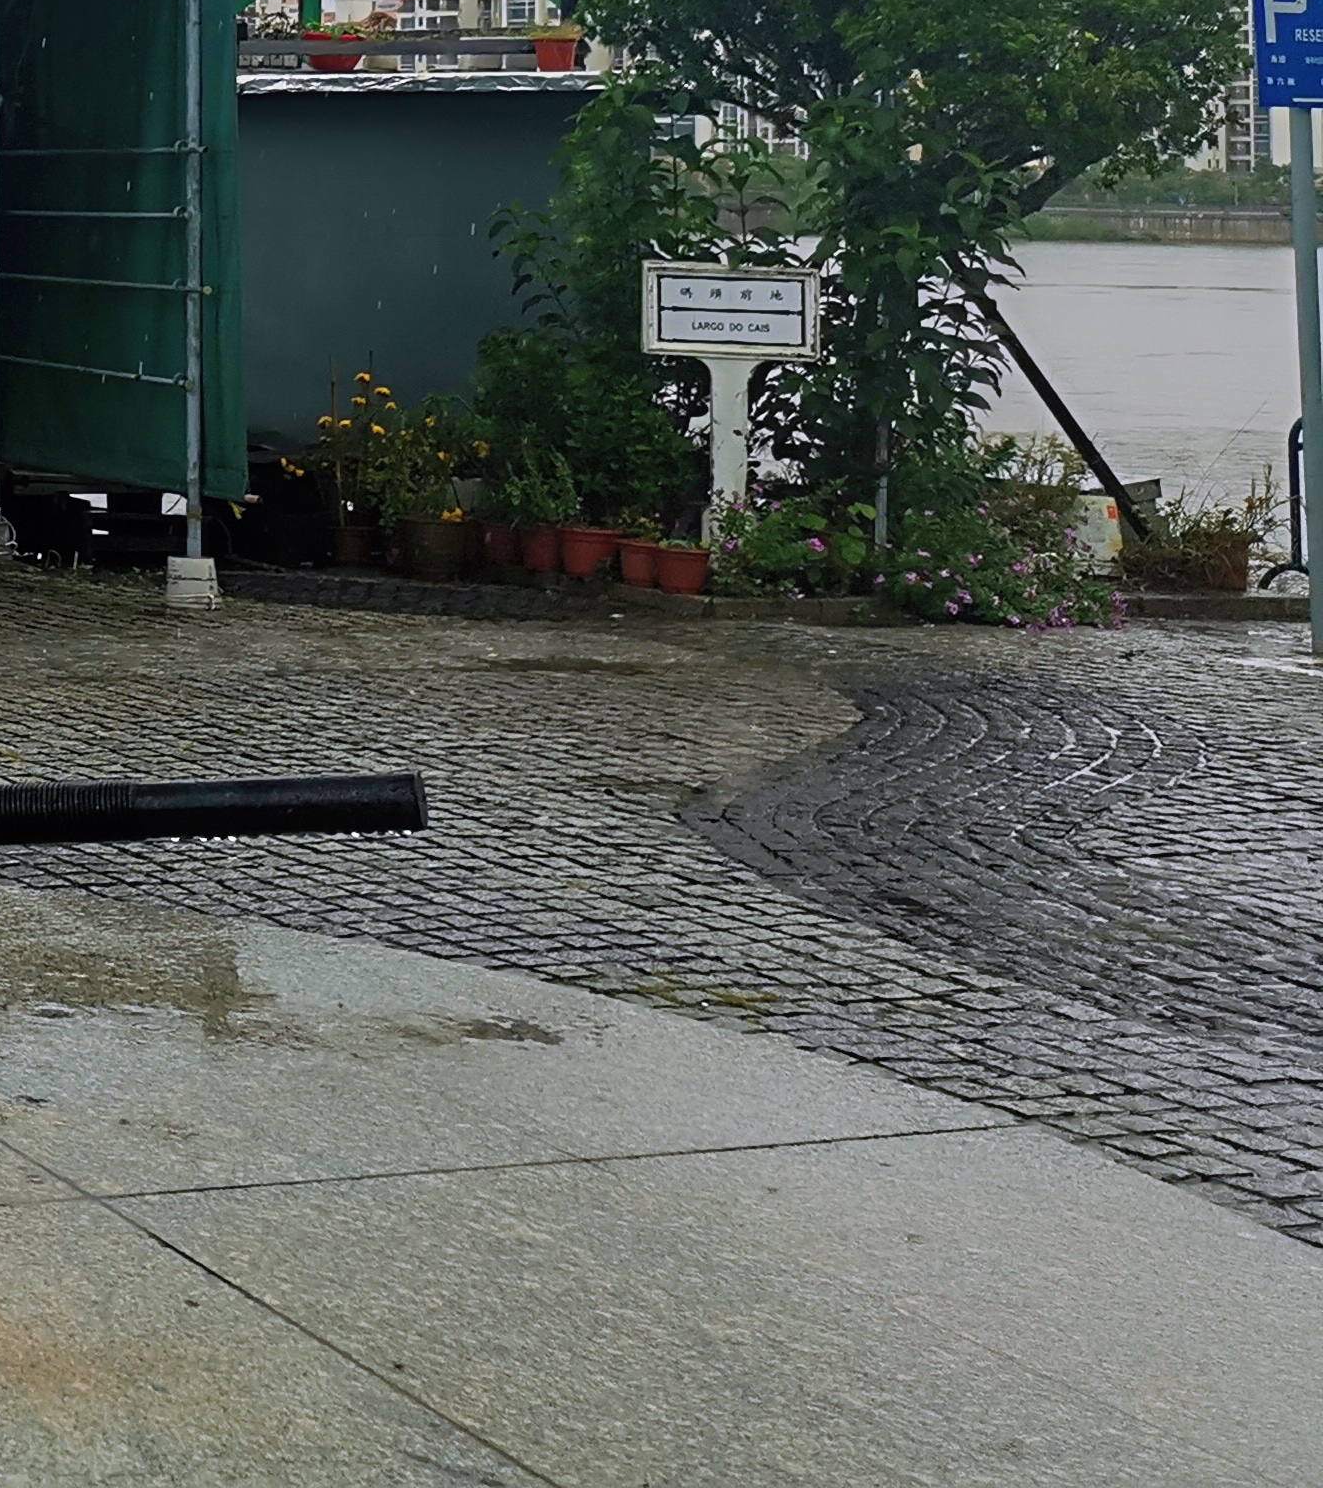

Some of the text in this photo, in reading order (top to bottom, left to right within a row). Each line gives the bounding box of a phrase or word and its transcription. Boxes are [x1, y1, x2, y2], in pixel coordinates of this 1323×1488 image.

[692, 321, 771, 333] LARGO DO CAIS
